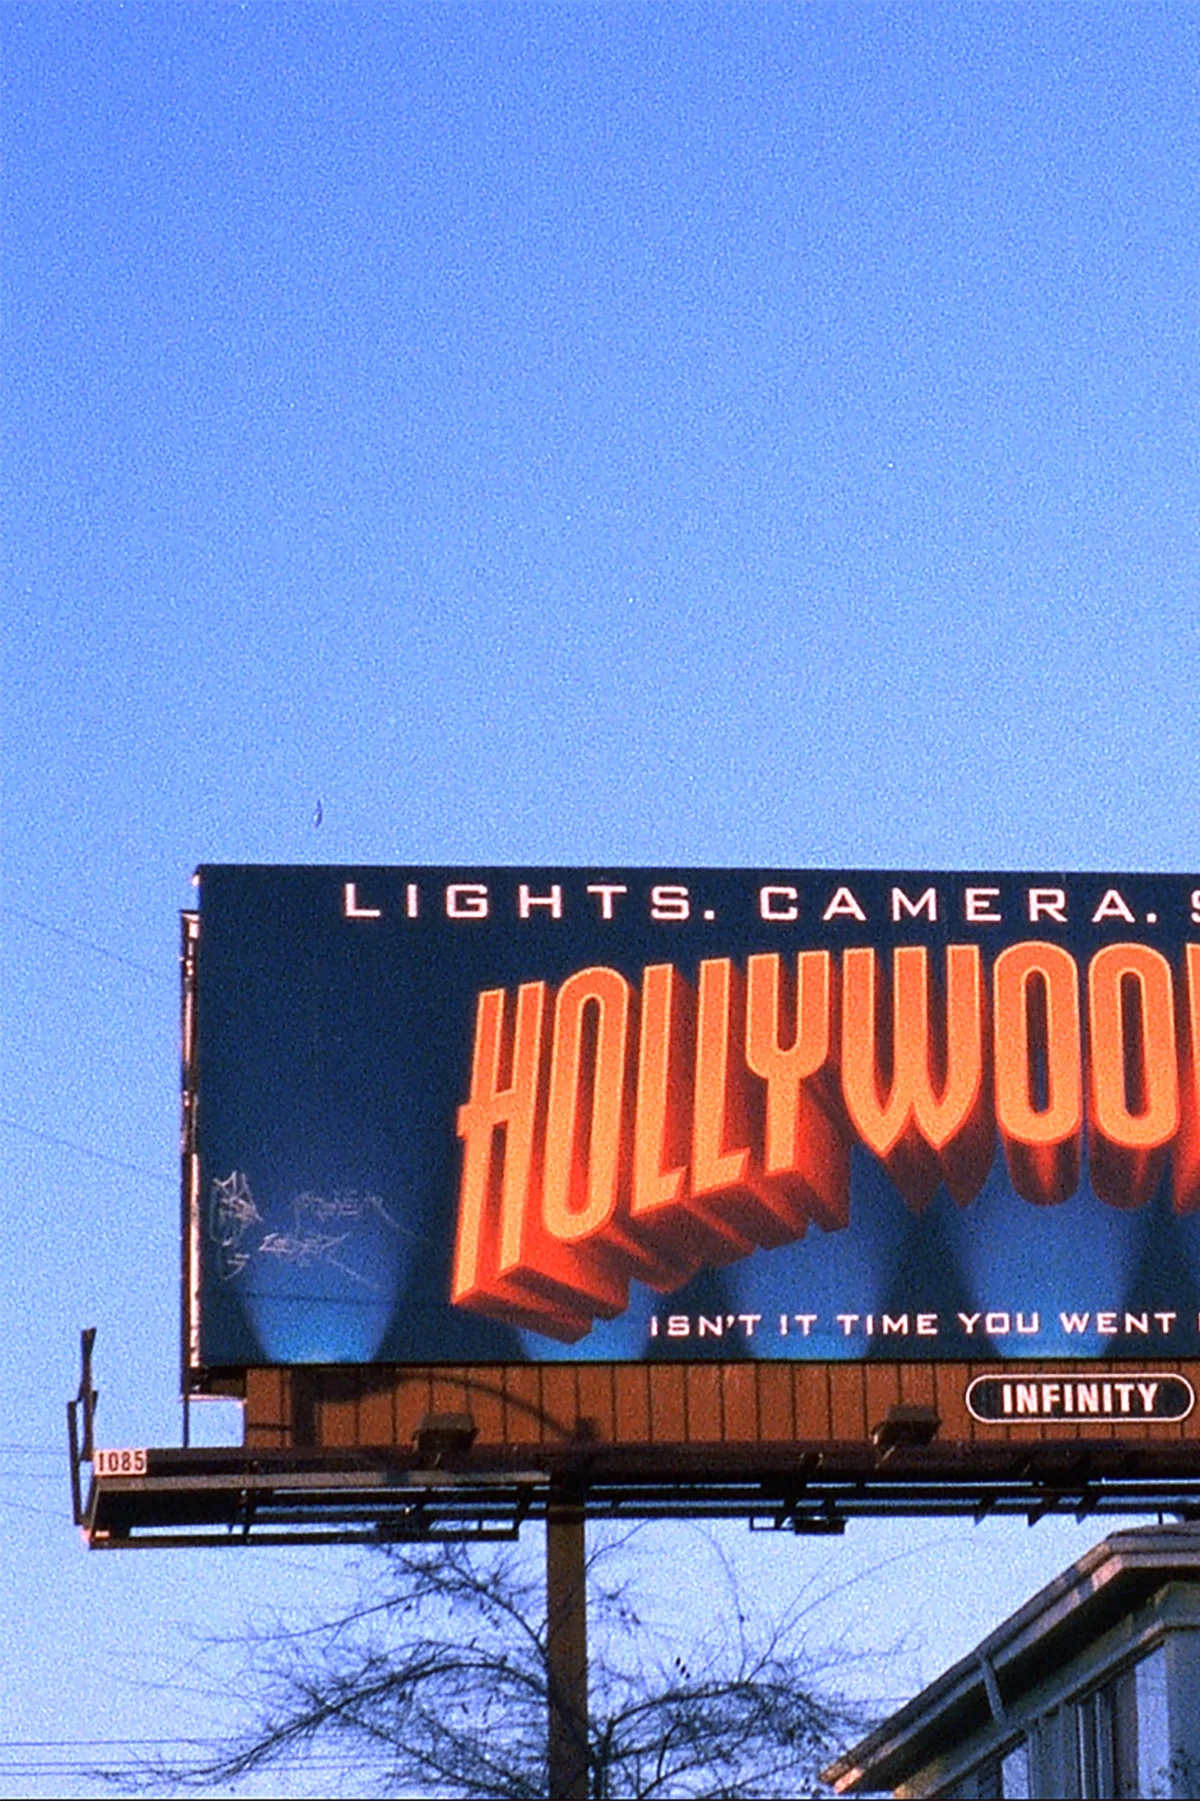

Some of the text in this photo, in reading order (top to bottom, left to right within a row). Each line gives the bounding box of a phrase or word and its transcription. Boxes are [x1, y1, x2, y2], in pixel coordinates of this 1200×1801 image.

[344, 882, 715, 921] LIGHTS.
[759, 885, 1157, 924] CAMERA.
[650, 1313, 762, 1337] ISN'T
[779, 1313, 818, 1337] IT
[835, 1313, 938, 1336] TIME
[957, 1311, 1040, 1336] YOU
[1058, 1311, 1177, 1335] WENT
[1001, 1382, 1159, 1415] INFINITY
[97, 1451, 146, 1472] 1085
